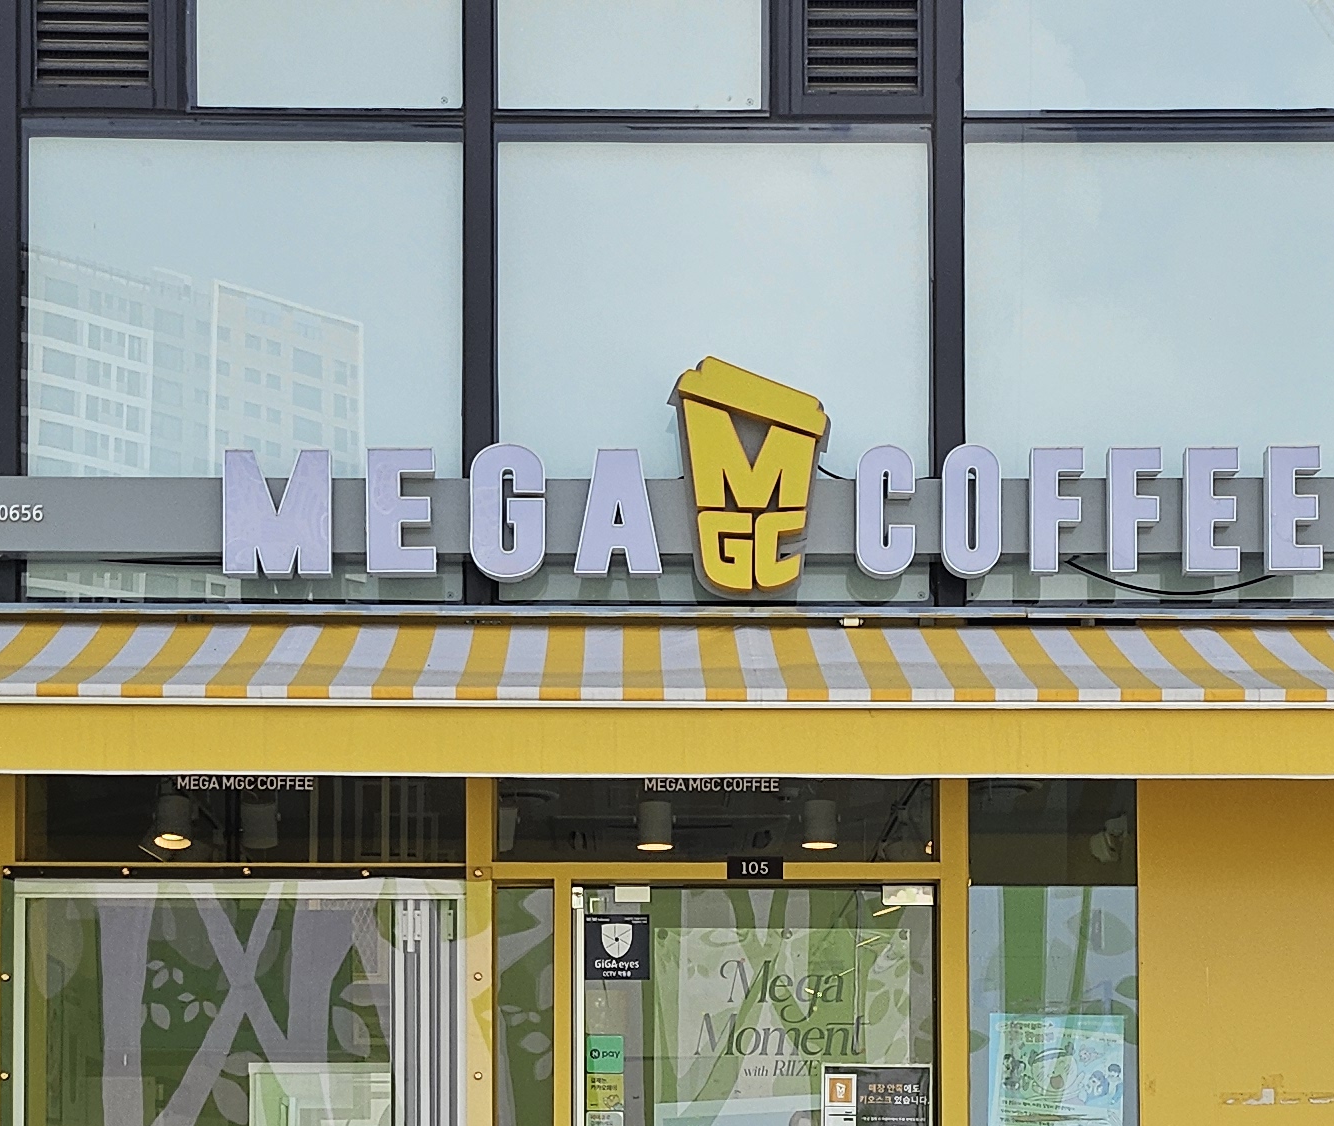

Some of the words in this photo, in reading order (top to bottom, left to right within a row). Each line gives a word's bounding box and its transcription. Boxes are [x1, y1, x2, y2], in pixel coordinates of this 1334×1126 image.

[222, 443, 663, 582] MEGA
[855, 444, 1324, 579] COFFEE
[177, 775, 220, 790] MEGA
[222, 776, 255, 791] MGC
[257, 776, 314, 791] COFFEE
[644, 778, 687, 792] MEGA
[688, 778, 722, 792] MGC
[723, 778, 780, 792] COFFEE
[741, 861, 769, 875] 105
[594, 959, 618, 969] GiGA
[618, 960, 640, 970] eyes
[719, 959, 845, 1024] Mega
[693, 1012, 871, 1057] Moment
[601, 1050, 621, 1059] pay
[743, 1065, 769, 1078] with
[772, 1059, 821, 1078] RIIZE
[859, 1095, 893, 1105] 키오스크
